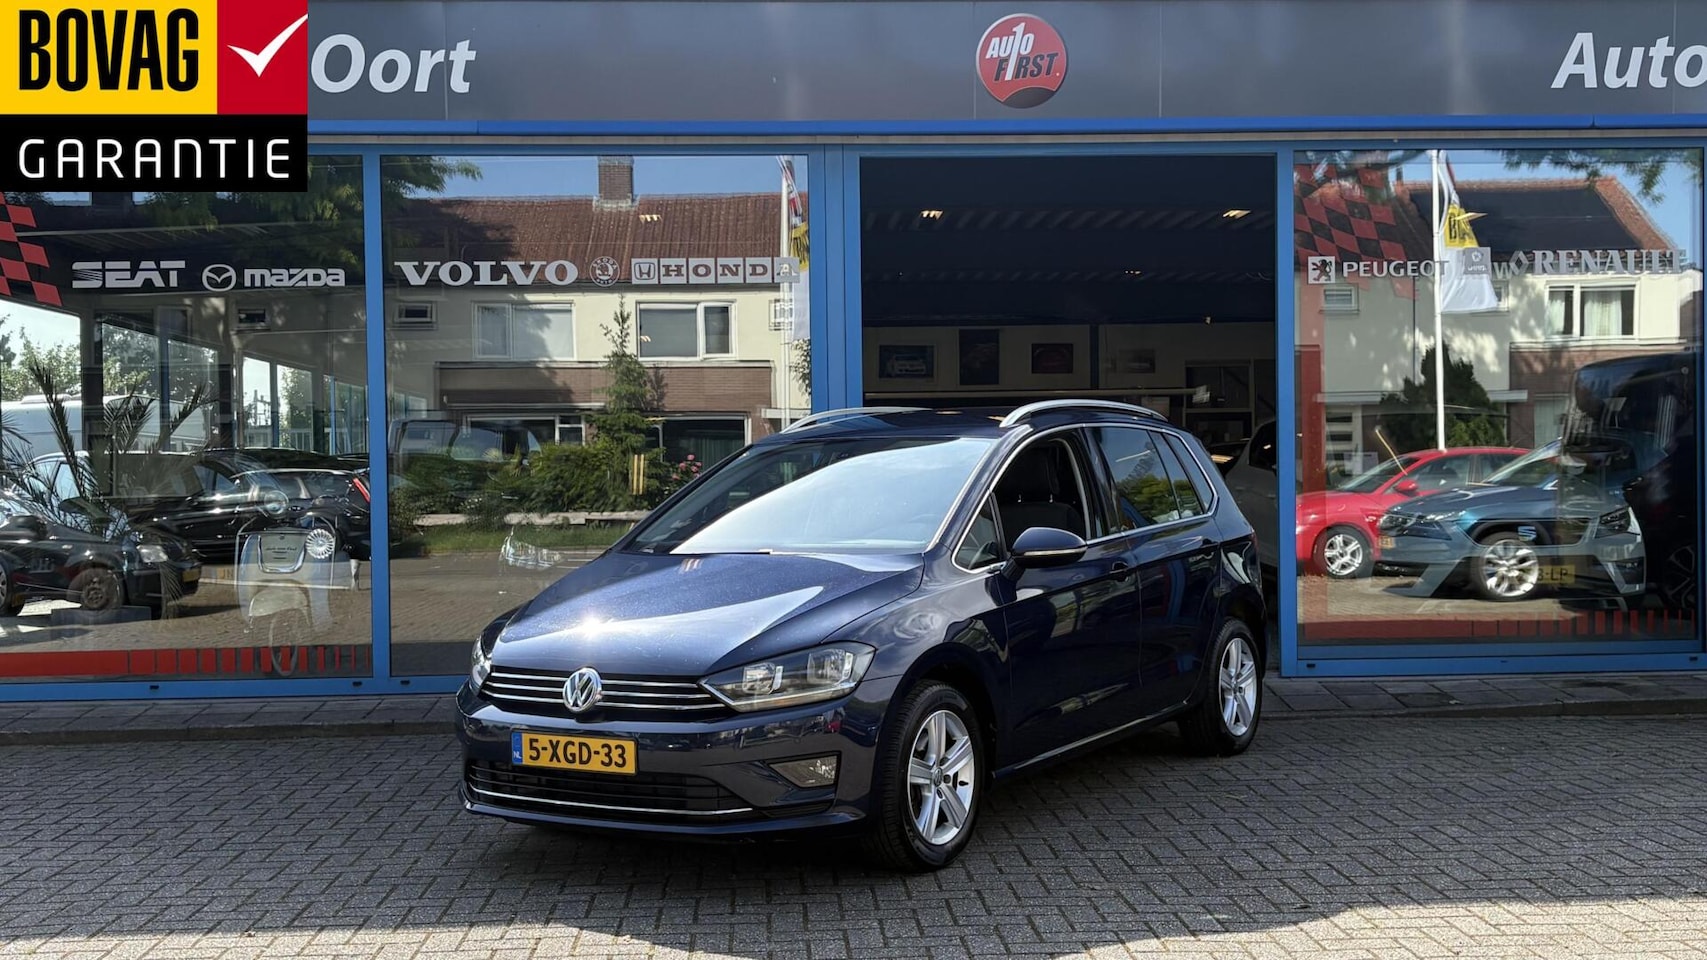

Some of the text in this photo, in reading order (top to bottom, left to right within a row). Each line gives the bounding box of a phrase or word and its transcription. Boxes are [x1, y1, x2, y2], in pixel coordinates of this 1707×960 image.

[310, 33, 477, 94] Oort
[1550, 32, 1707, 89] Auto
[71, 260, 186, 289] SEAT
[394, 259, 578, 287] VOLVO
[661, 261, 799, 280] HONDA
[1342, 260, 1450, 278] PEUGEOT
[1533, 249, 1687, 275] RENAULT
[513, 751, 523, 759] NL
[528, 738, 627, 769] 5-XGD-33
